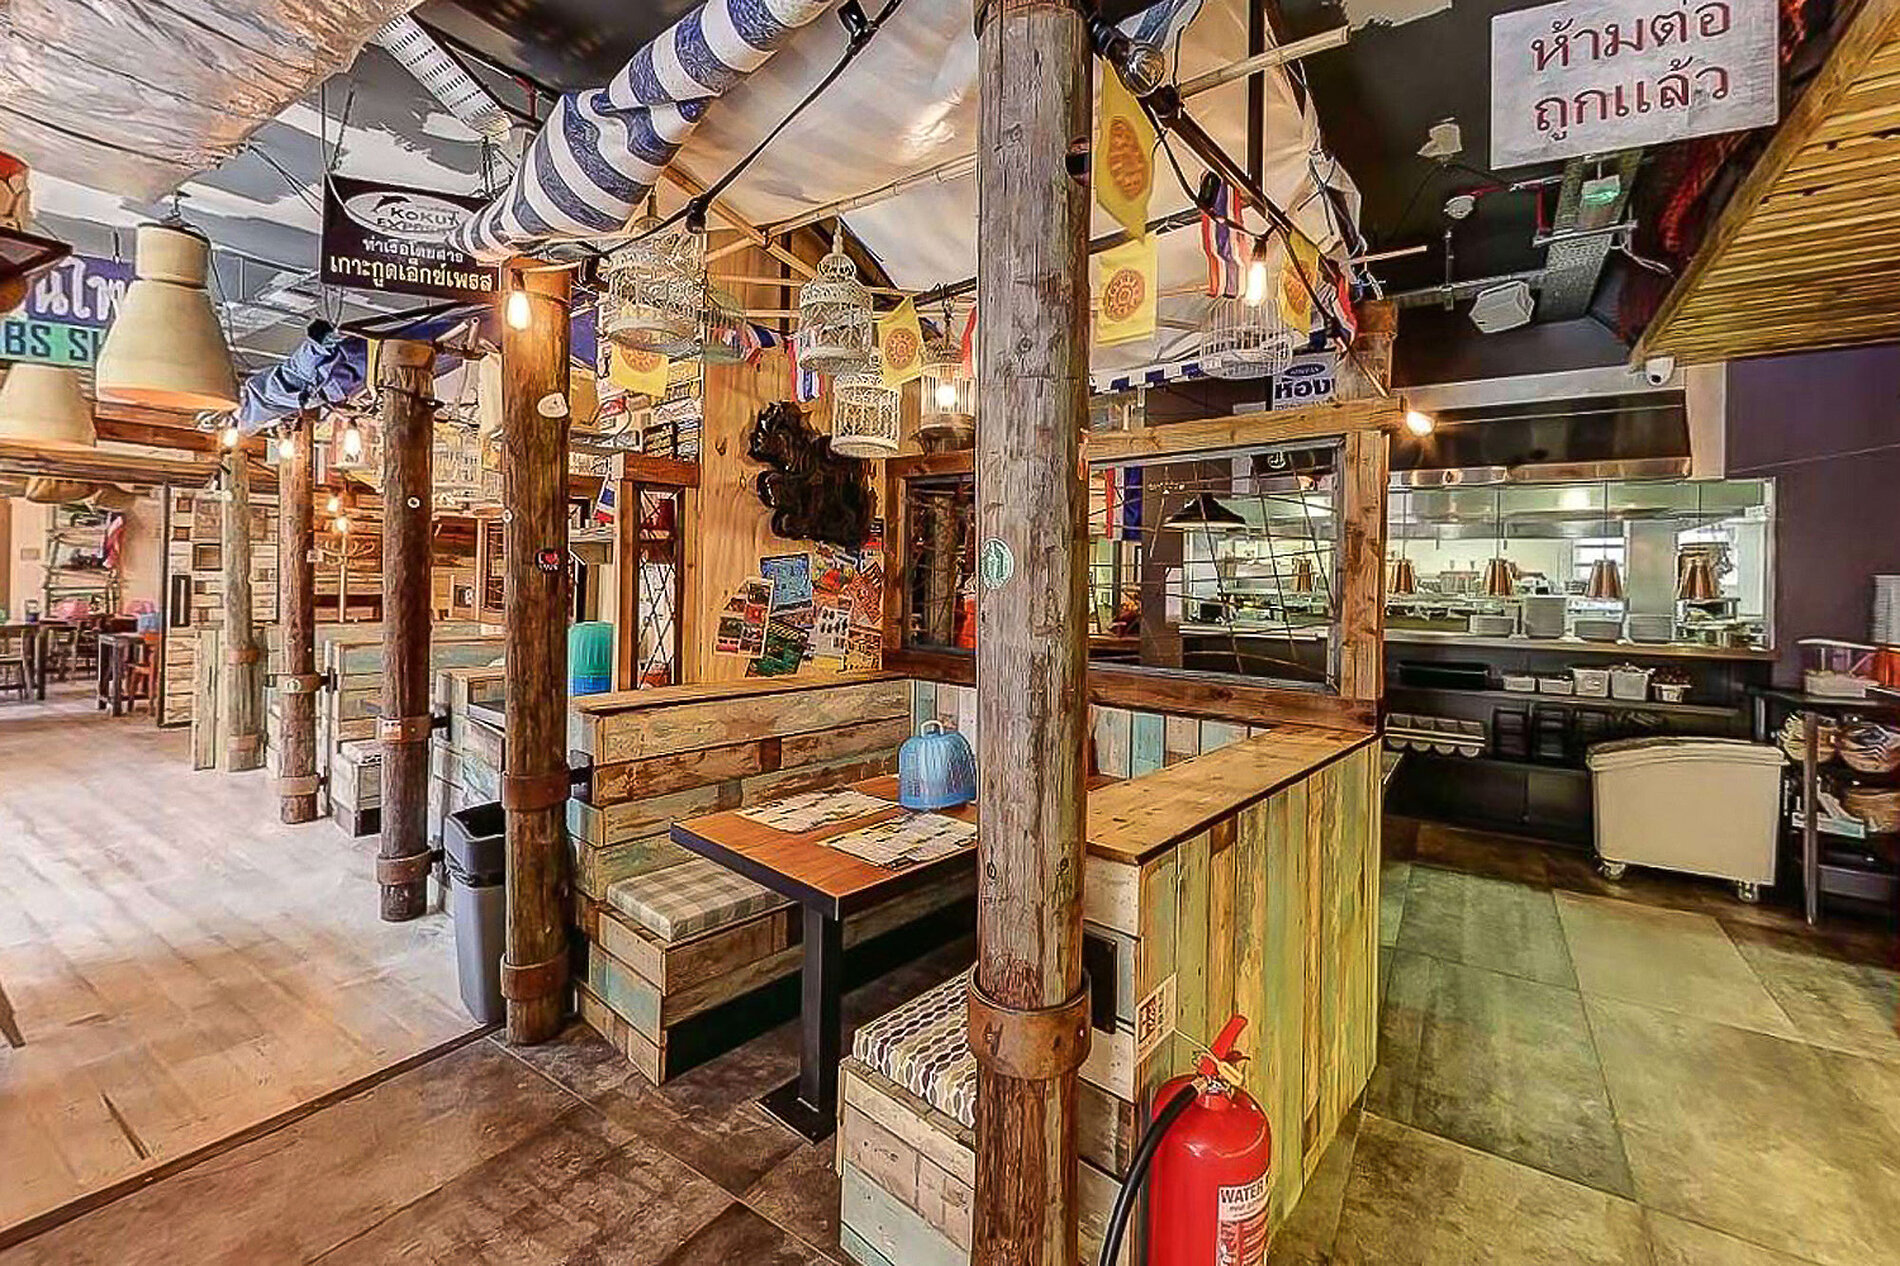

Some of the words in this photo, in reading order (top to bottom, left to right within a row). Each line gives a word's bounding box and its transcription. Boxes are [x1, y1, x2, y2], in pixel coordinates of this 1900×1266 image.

[1534, 56, 1730, 141] ถูกแล้ว
[1220, 1179, 1264, 1204] WATER
